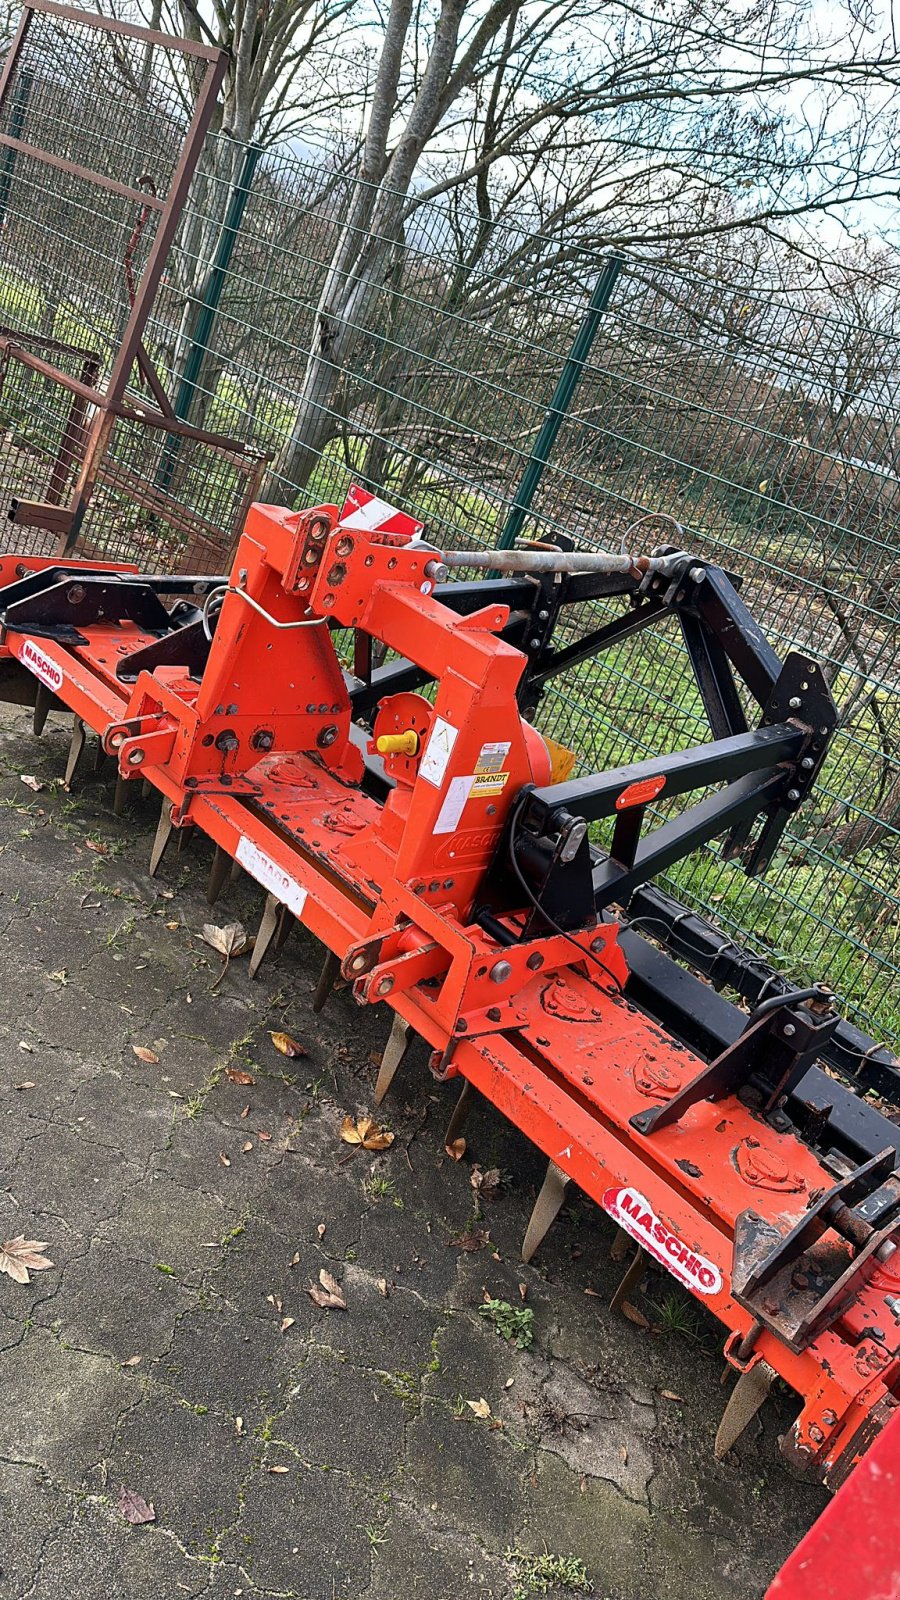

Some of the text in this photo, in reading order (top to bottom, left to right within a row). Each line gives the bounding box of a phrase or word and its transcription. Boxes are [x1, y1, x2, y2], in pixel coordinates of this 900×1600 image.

[25, 645, 61, 685] MASCHIO
[475, 774, 507, 784] BRANDT
[449, 832, 501, 851] MASCH
[620, 1193, 716, 1288] MASCHIO
